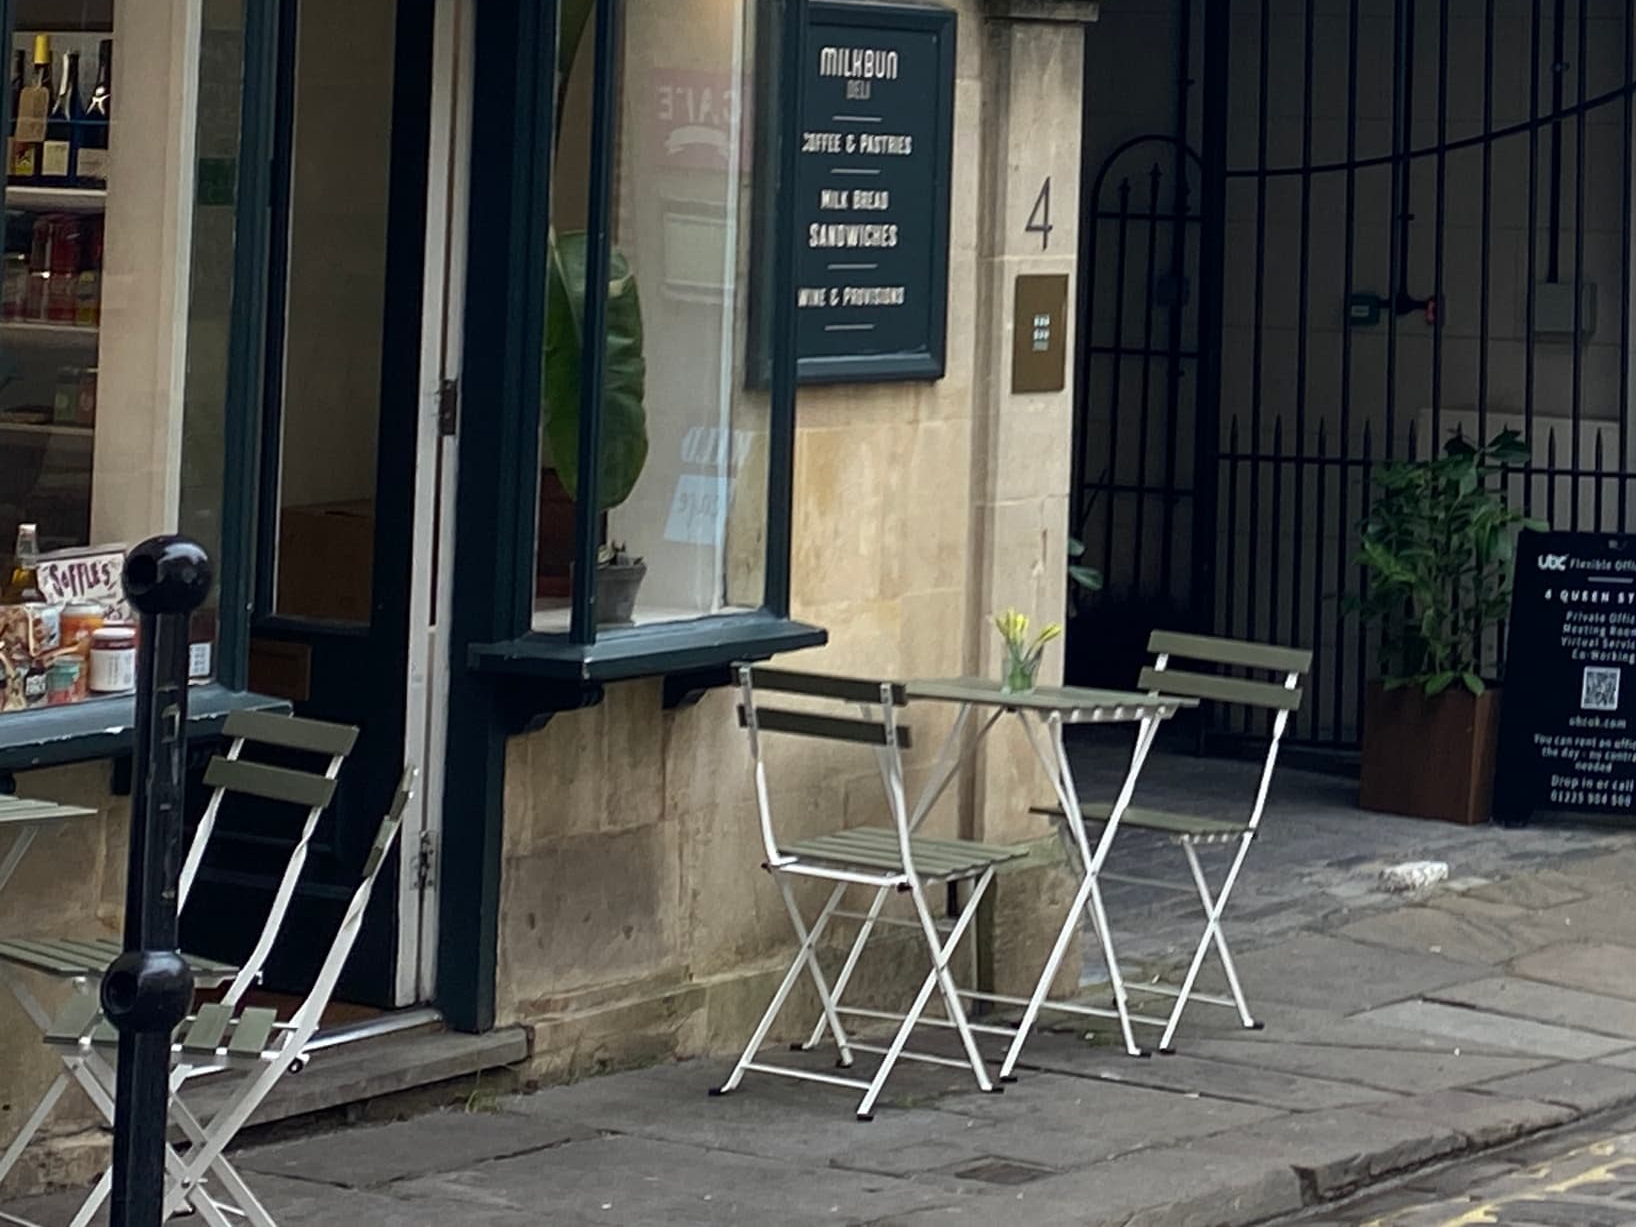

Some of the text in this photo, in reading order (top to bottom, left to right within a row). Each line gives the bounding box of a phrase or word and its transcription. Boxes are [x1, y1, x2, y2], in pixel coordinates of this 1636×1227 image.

[820, 47, 898, 80] MILKBUN
[859, 133, 912, 155] PASTRIES
[820, 189, 849, 210] MILK
[1025, 176, 1053, 252] 4
[809, 223, 898, 247] SANDWICHES
[1569, 558, 1612, 571] Flexible
[1560, 589, 1610, 603] QUEEN
[1566, 610, 1606, 624] Private
[1563, 623, 1606, 638] Meeting
[1561, 636, 1600, 648] Virtual
[1551, 773, 1579, 789] Drop
